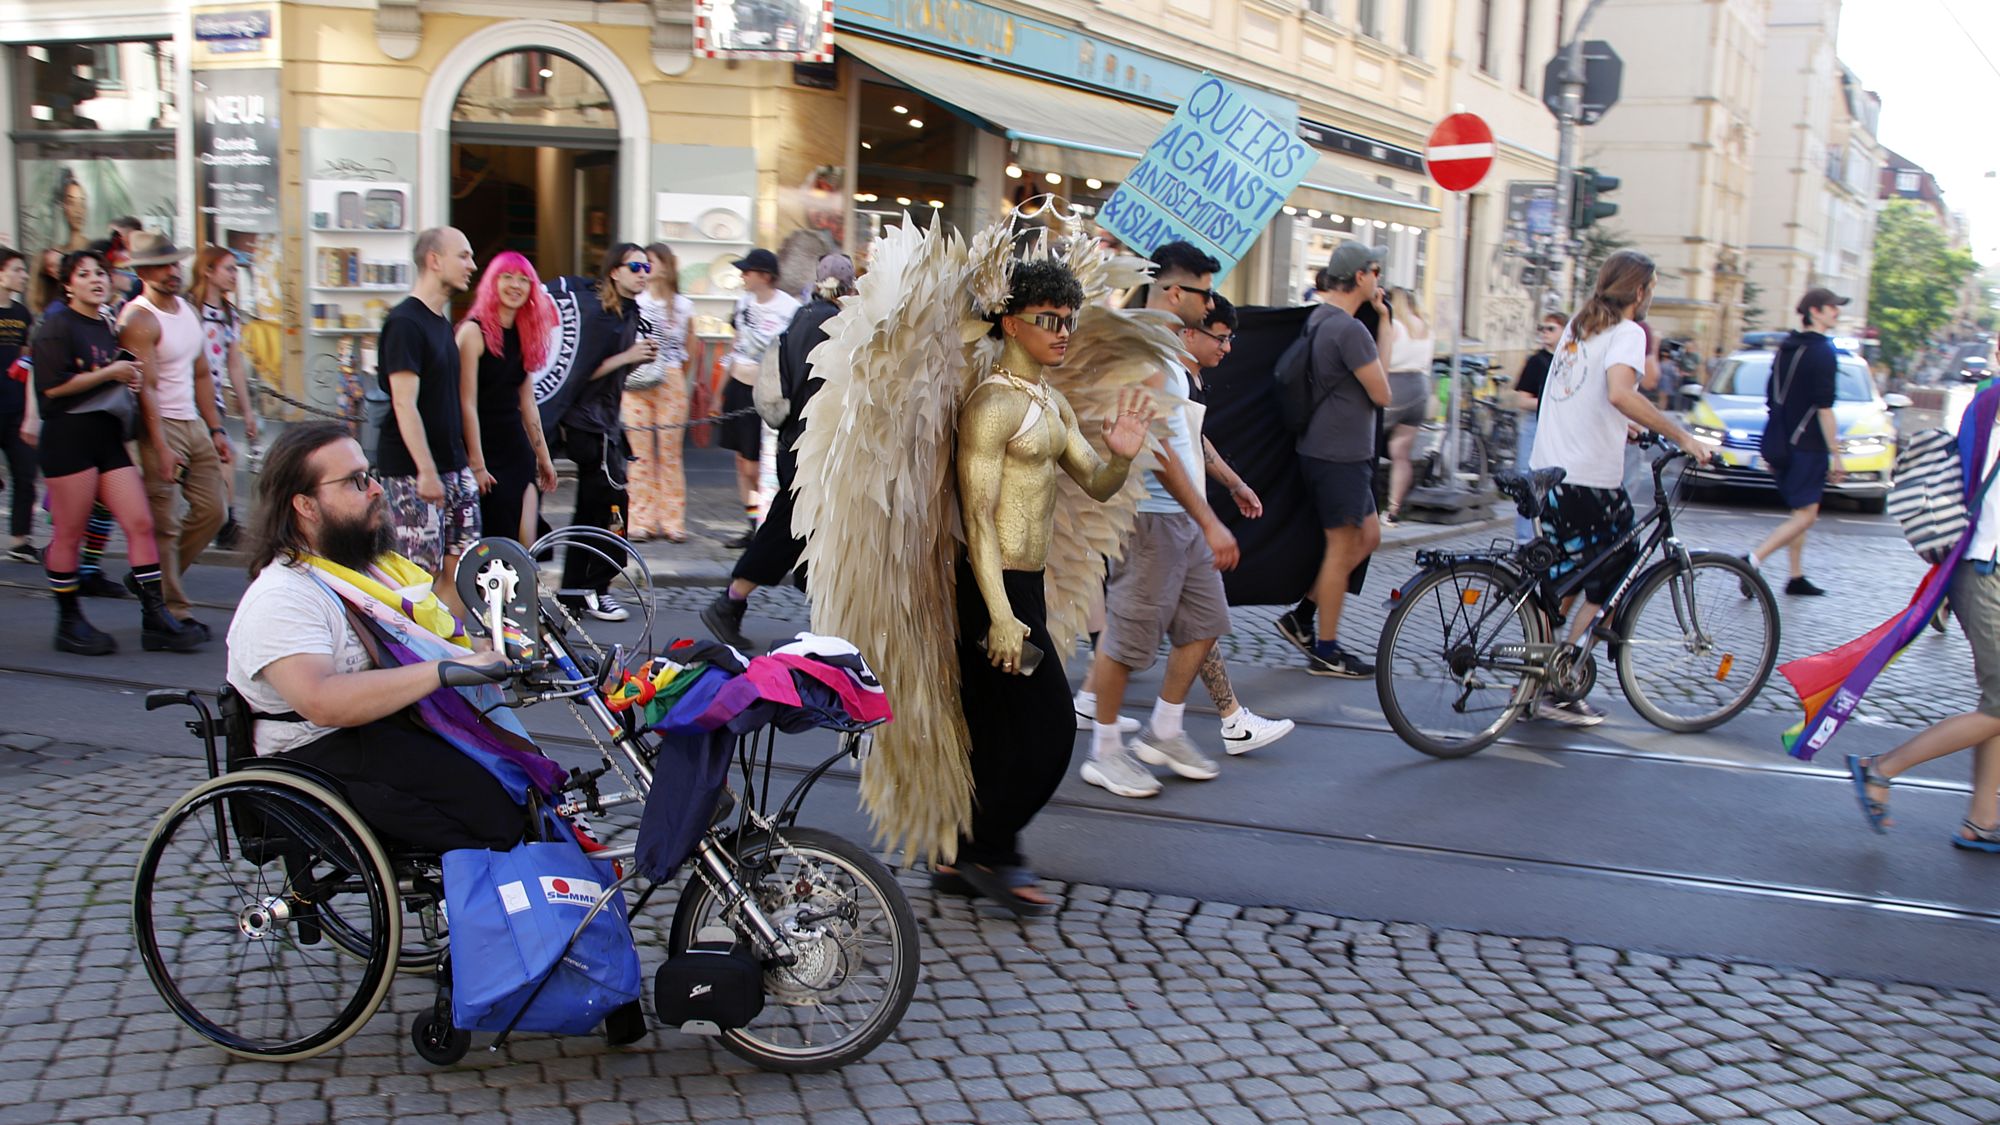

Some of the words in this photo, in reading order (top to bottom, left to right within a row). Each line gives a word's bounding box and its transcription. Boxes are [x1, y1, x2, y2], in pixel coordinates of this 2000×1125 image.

[1152, 123, 1284, 221] AGAINST
[1188, 78, 1305, 179] QUEERS
[1114, 201, 1195, 254] ISLAM
[1128, 160, 1252, 254] ANTISEMITISM
